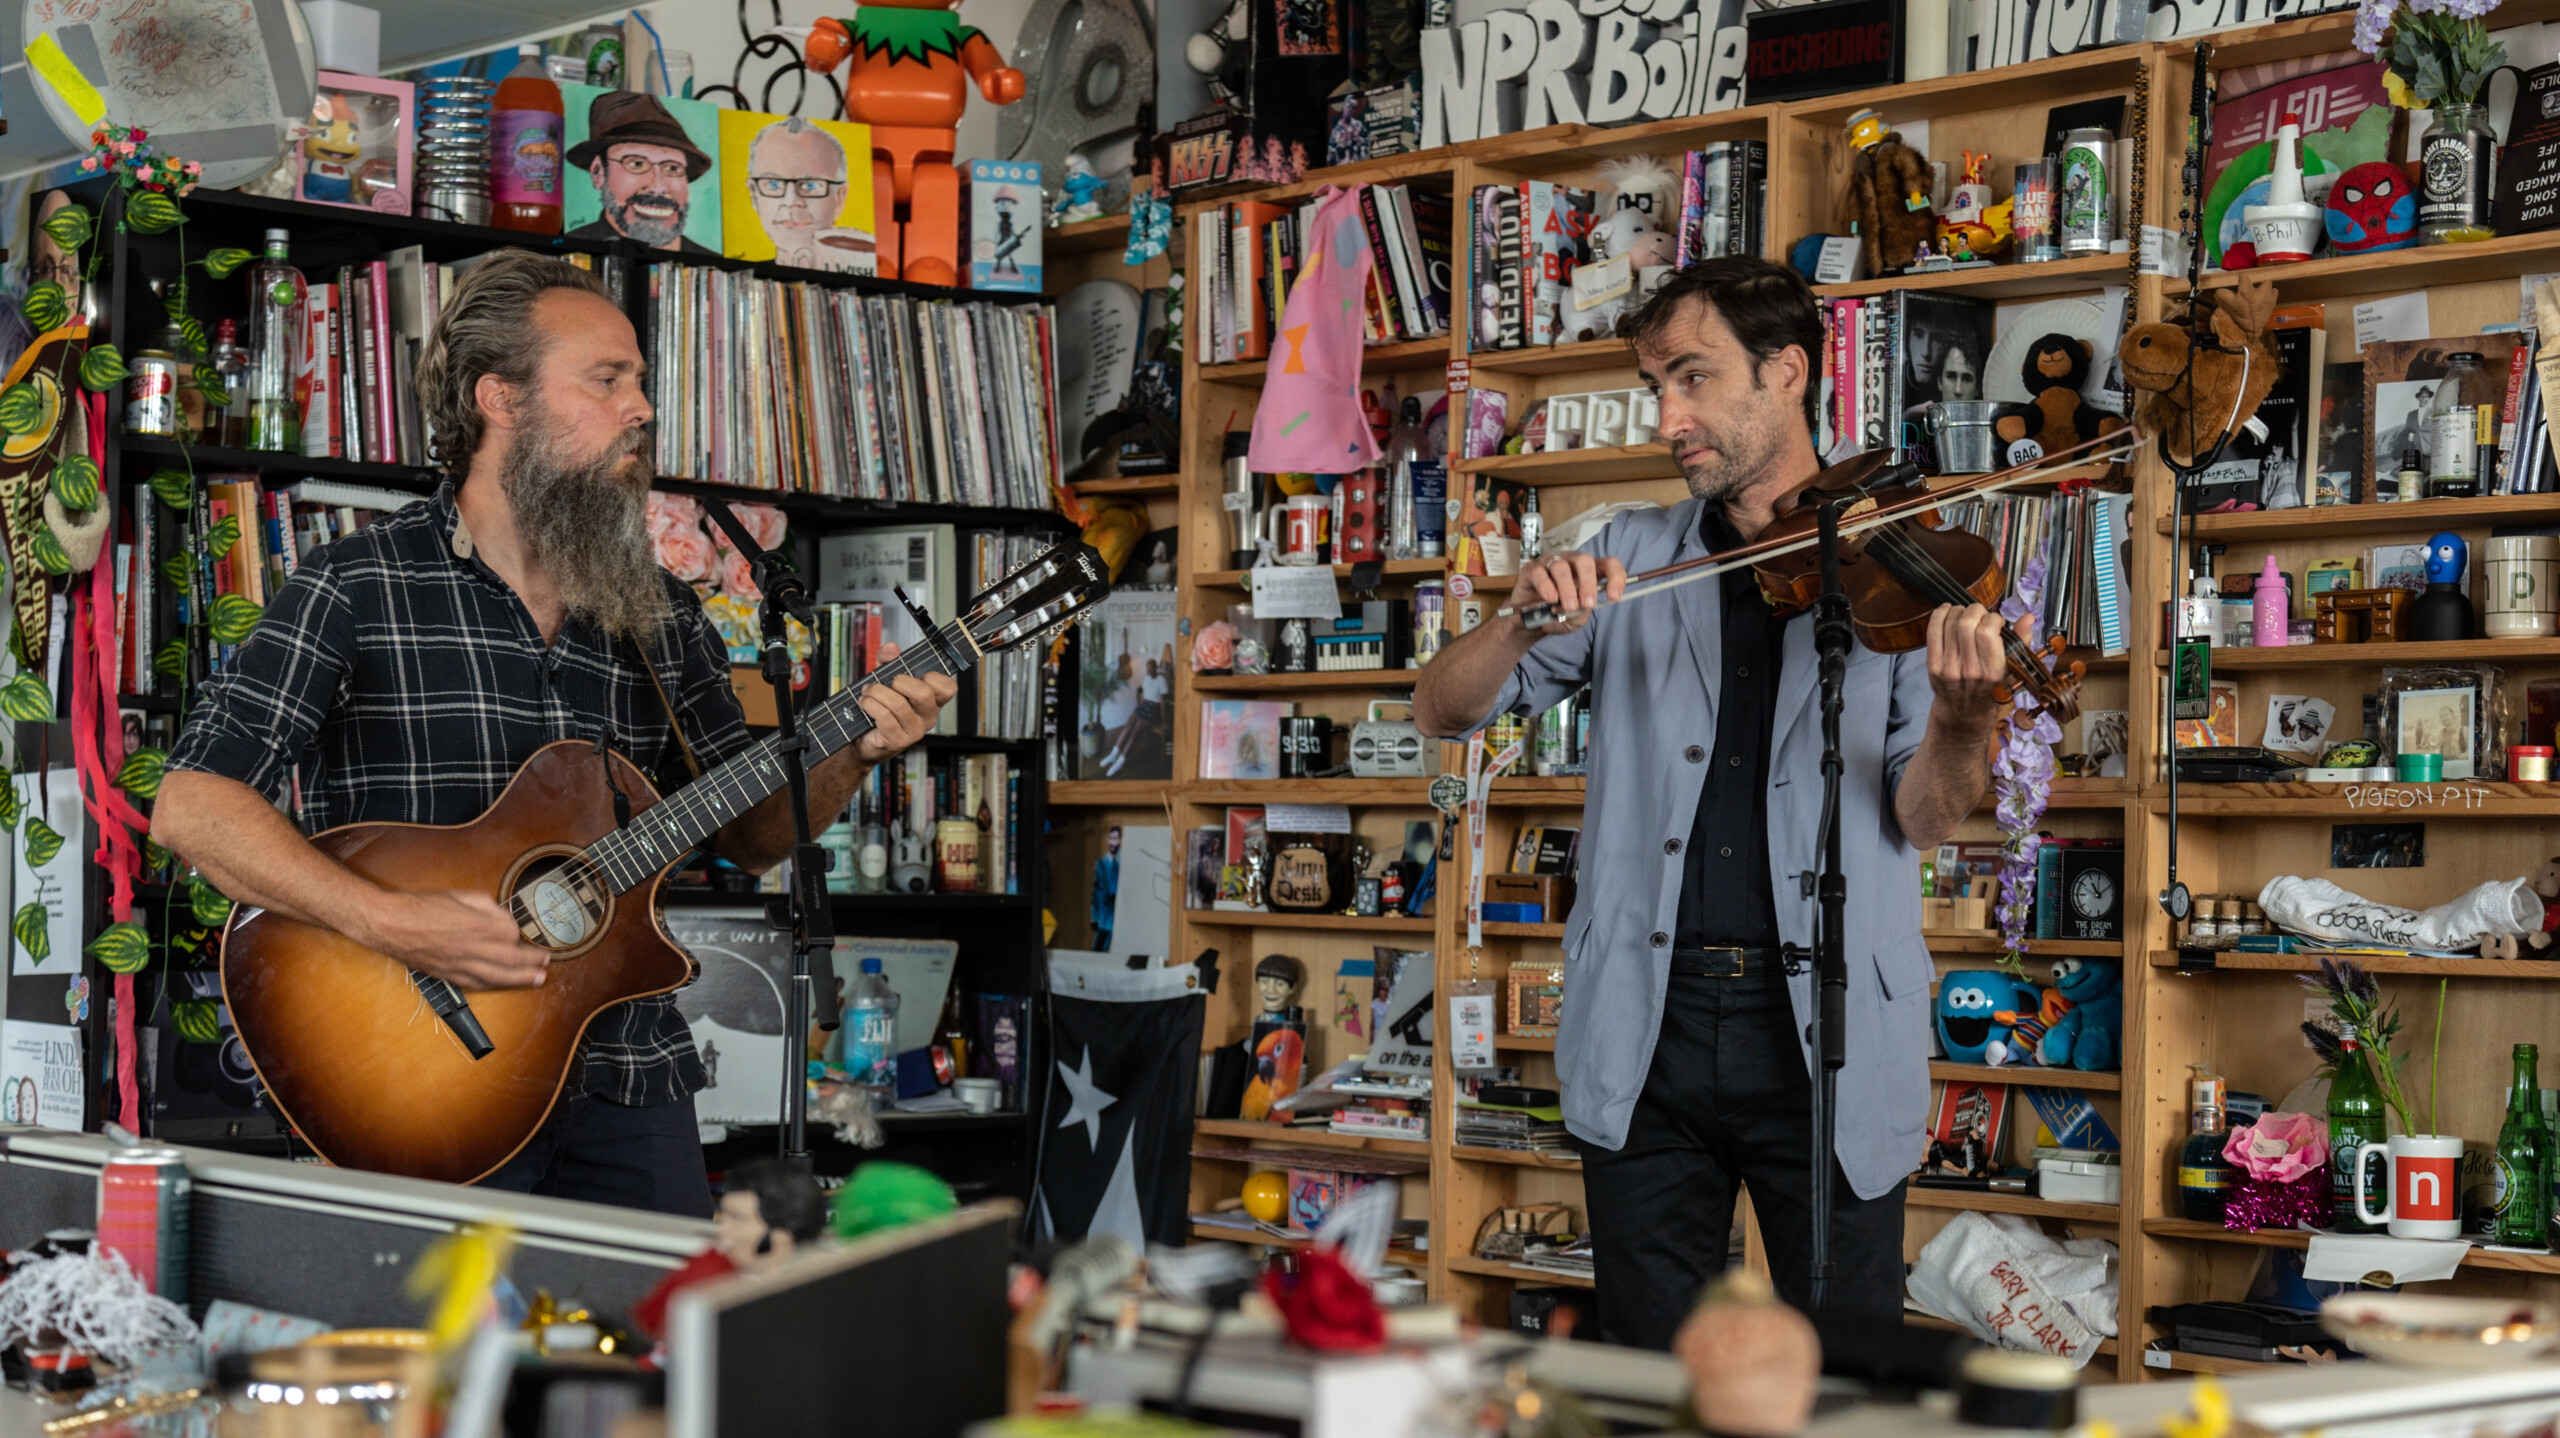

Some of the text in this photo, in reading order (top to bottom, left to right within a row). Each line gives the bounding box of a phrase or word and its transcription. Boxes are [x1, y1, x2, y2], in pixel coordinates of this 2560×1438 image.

[1751, 21, 1891, 79] RECORDING
[1420, 0, 1588, 150] NPR
[1169, 130, 1233, 189] KISS
[2075, 151, 2103, 185] STREET
[1730, 156, 1742, 202] SEEING
[2014, 191, 2048, 205] BLUE
[2439, 203, 2455, 211] PASTA
[2456, 202, 2473, 212] SAUCE
[2525, 188, 2557, 205] SONG
[1729, 202, 1741, 226] THE
[2014, 204, 2048, 218] MAN
[2014, 217, 2048, 228] GROUP
[2521, 205, 2553, 221] YOUR
[1520, 193, 1532, 254] ASK BOB
[2253, 219, 2303, 243] B-Phill
[836, 263, 875, 278] WISH
[1543, 252, 1596, 285] BO
[2357, 307, 2374, 316] David
[2357, 314, 2383, 325] McKinzie
[329, 311, 338, 356] OUR NOISE
[1837, 306, 1847, 348] GOOD
[1865, 298, 1885, 363] THIS
[1837, 350, 1847, 374] BOOTY
[1838, 395, 1846, 416] ANN
[2315, 486, 2346, 498] ERSAL
[1291, 519, 1309, 546] n
[1076, 551, 1098, 582] Taylor
[2510, 571, 2535, 609] p
[14, 575, 42, 662] MAGIC
[31, 578, 48, 648] GIRL
[1107, 601, 1142, 612] mirror
[2175, 700, 2207, 716] RODUCTION
[1282, 736, 1321, 754] 9:30
[2344, 785, 2490, 809] PIGEON PIT
[1540, 856, 1559, 864] CENTER
[1542, 849, 1566, 858] HYPNOSIS
[1277, 852, 1324, 883] Tiny
[1276, 880, 1323, 903] Desk
[2075, 920, 2112, 930] THE DREAM
[2080, 928, 2106, 938] IS OVER
[2370, 919, 2418, 946] SWEAT
[681, 931, 779, 945] ESK UNIT
[1379, 1051, 1397, 1065] on
[1398, 1050, 1420, 1067] the
[44, 1066, 61, 1080] MAY
[62, 1069, 81, 1095] OH
[43, 1079, 61, 1092] HAN
[2341, 1126, 2355, 1134] THE
[2410, 1171, 2440, 1206] n
[1986, 1302, 2015, 1334] JR
[1990, 1260, 2078, 1359] GARY CLARK
